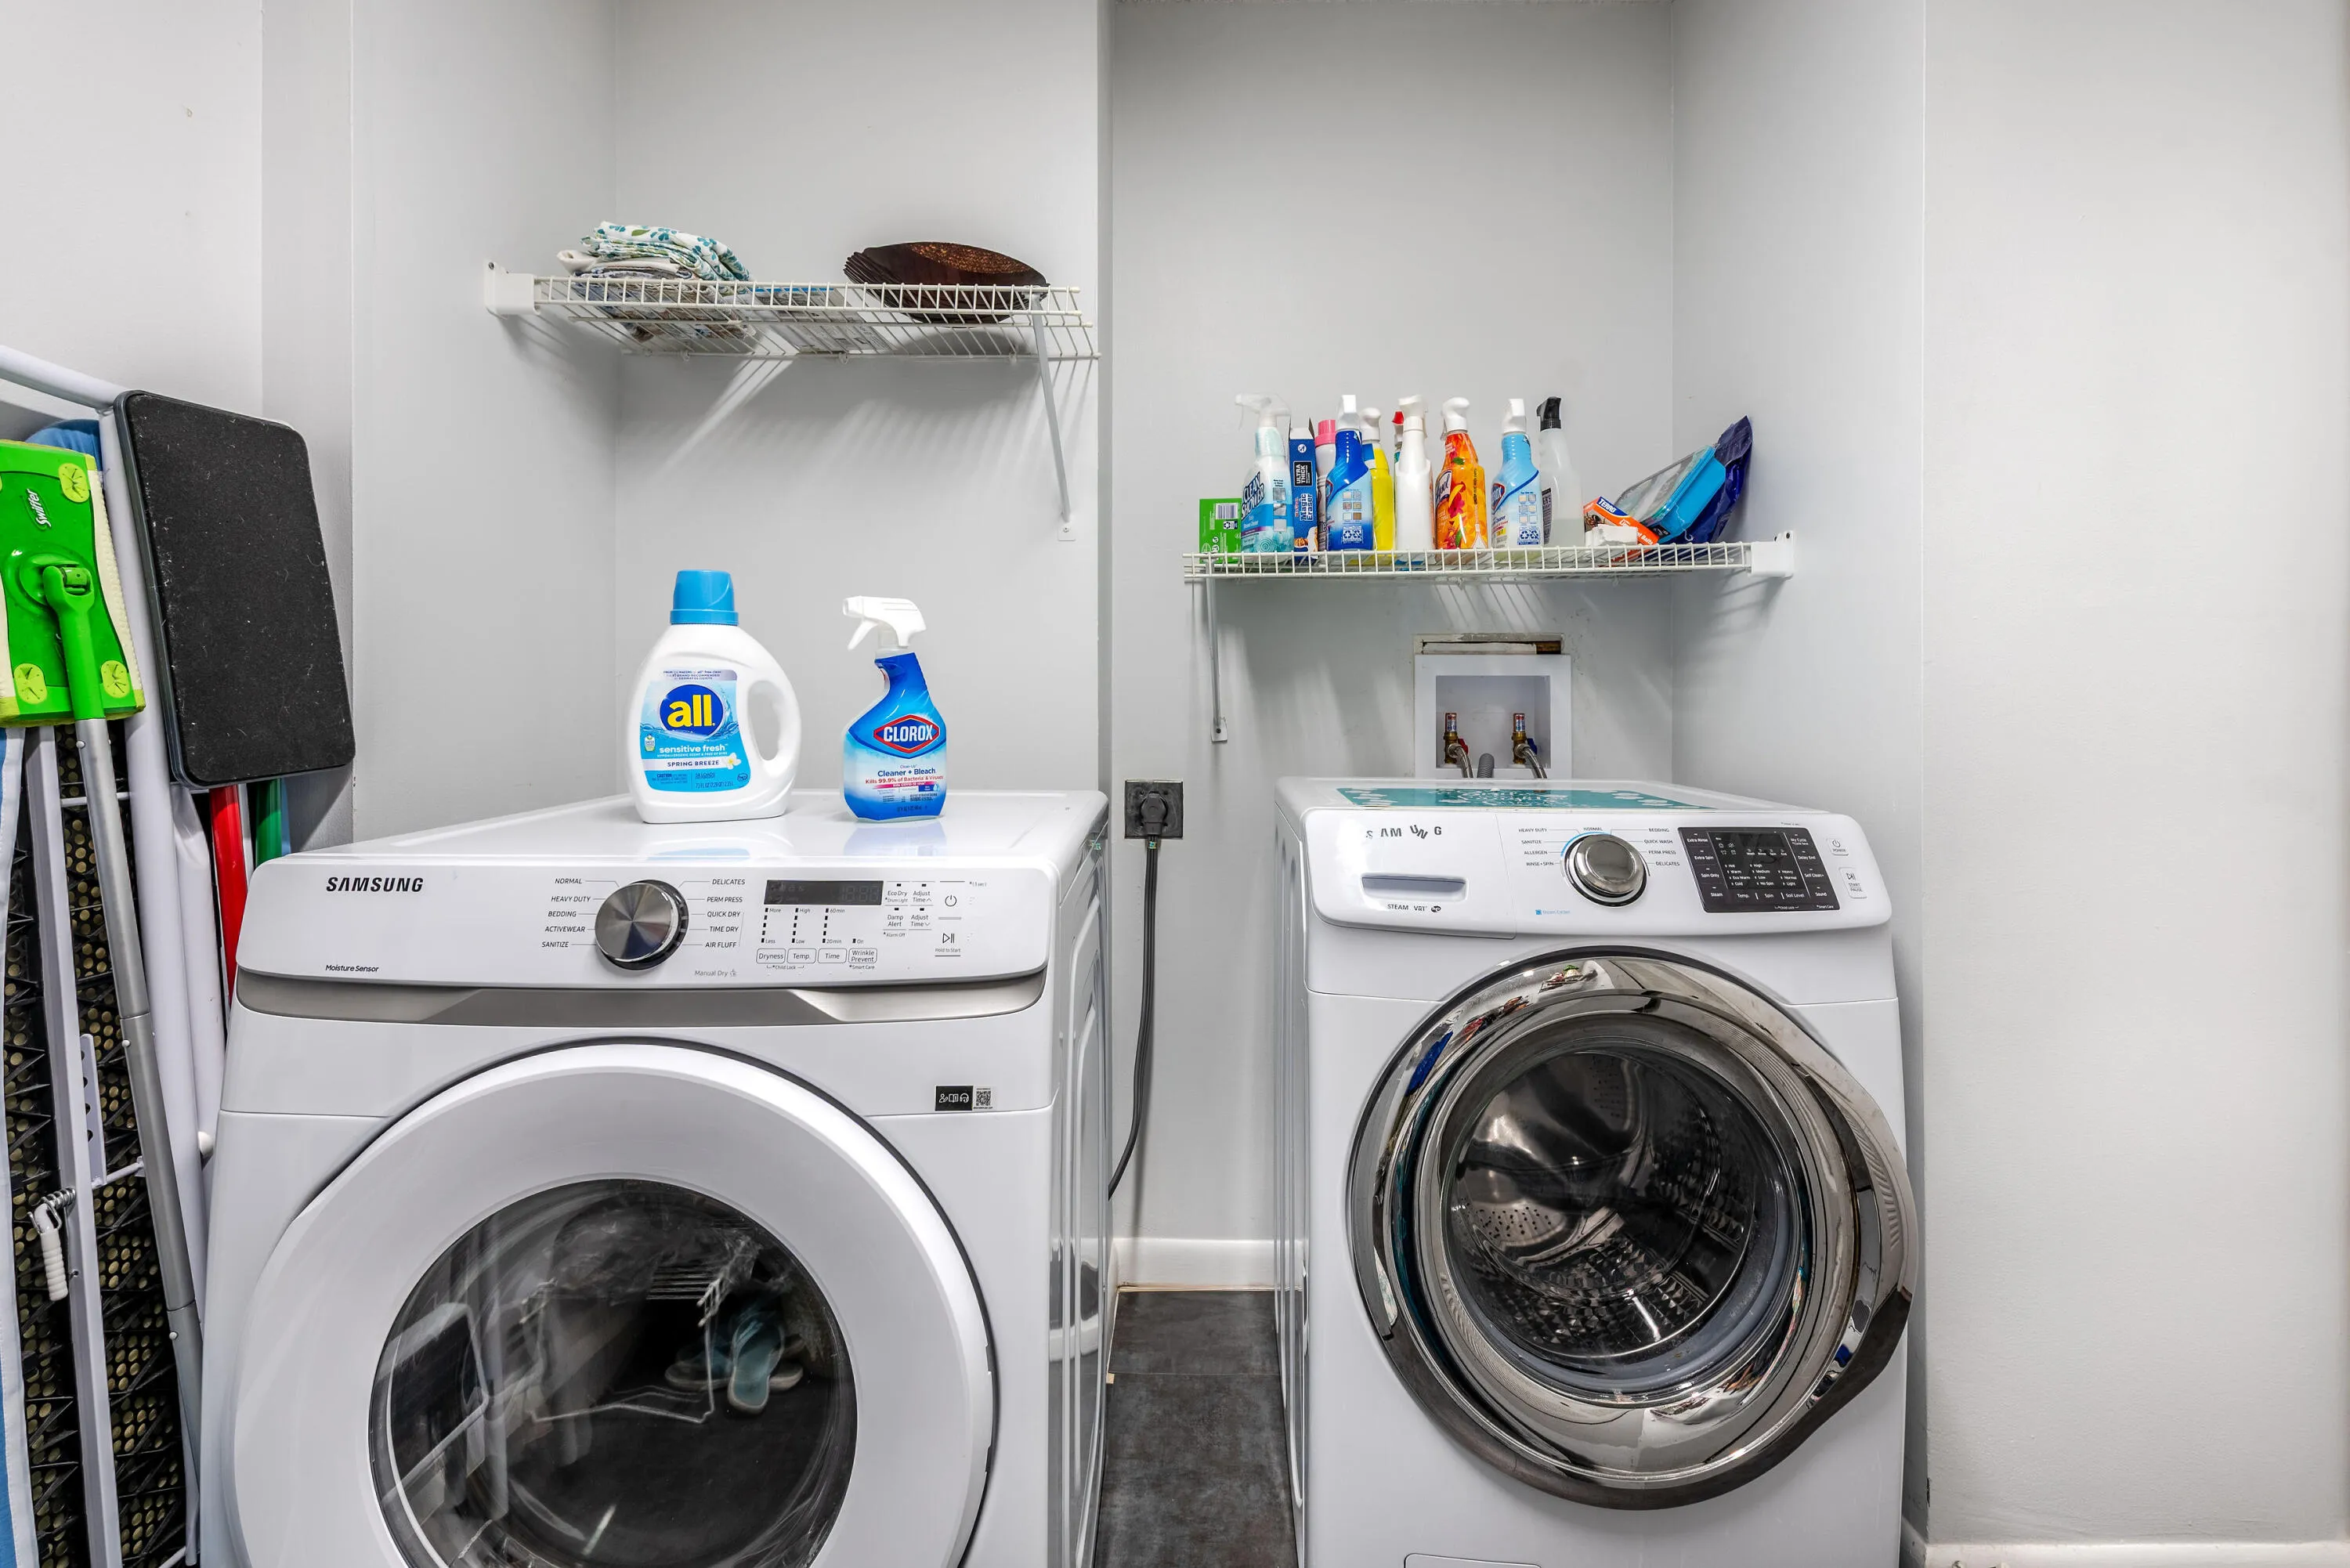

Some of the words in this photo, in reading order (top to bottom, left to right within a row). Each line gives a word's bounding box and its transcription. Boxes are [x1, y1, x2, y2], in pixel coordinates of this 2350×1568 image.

[1243, 471, 1260, 503] CLEAN
[27, 488, 51, 527] Swiffer
[1241, 483, 1264, 520] SHOWER
[1598, 499, 1616, 513] TERRO
[667, 695, 711, 727] all
[884, 725, 933, 742] CLOROX
[659, 745, 701, 753] sensitive
[326, 877, 423, 892] SAMSUNG
